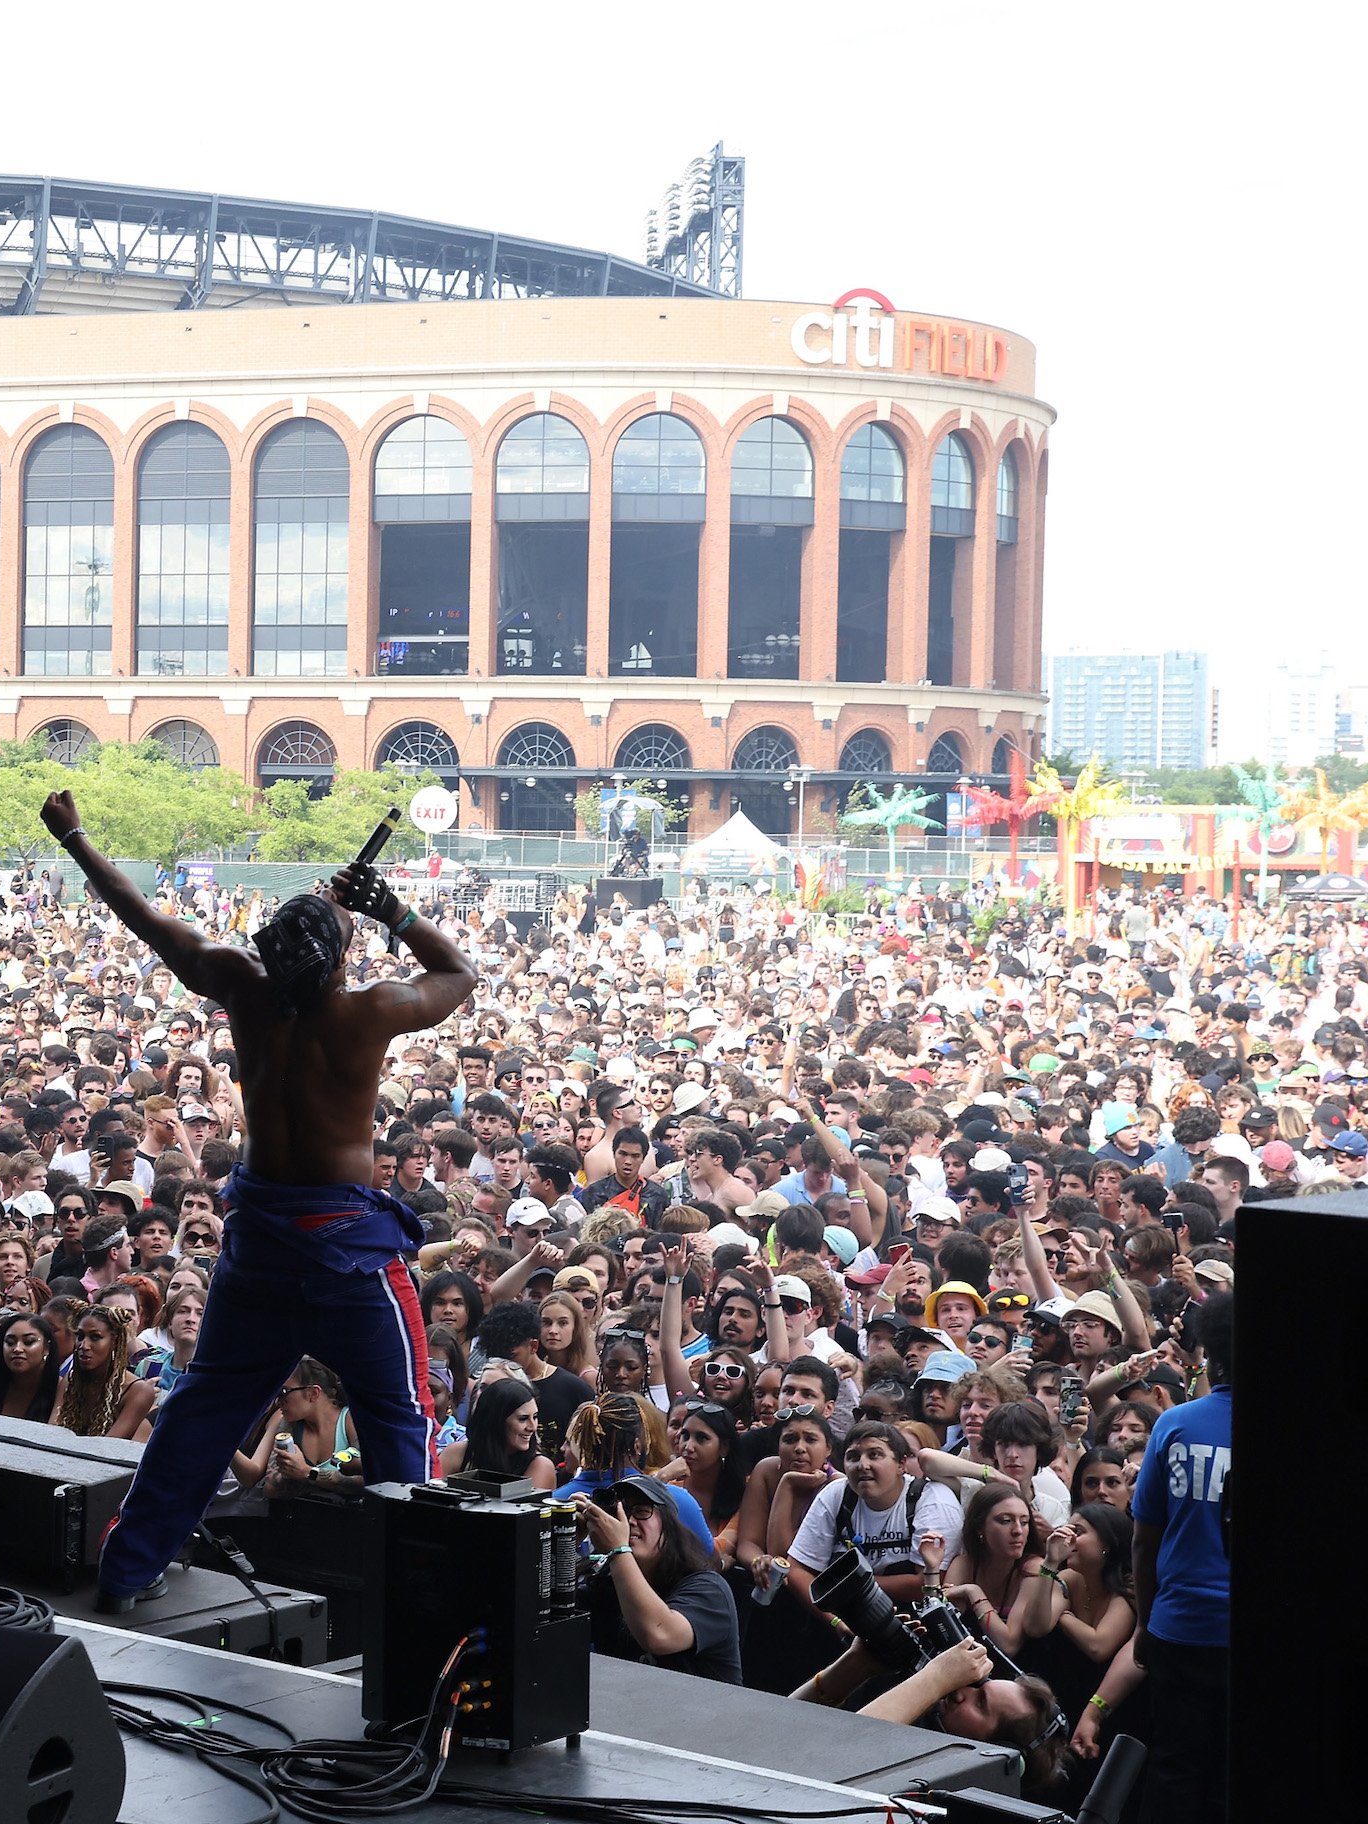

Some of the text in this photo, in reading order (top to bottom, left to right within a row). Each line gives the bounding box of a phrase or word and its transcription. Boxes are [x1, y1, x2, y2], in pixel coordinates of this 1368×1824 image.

[790, 292, 1009, 382] citi FIELD
[416, 806, 446, 820] EXIT
